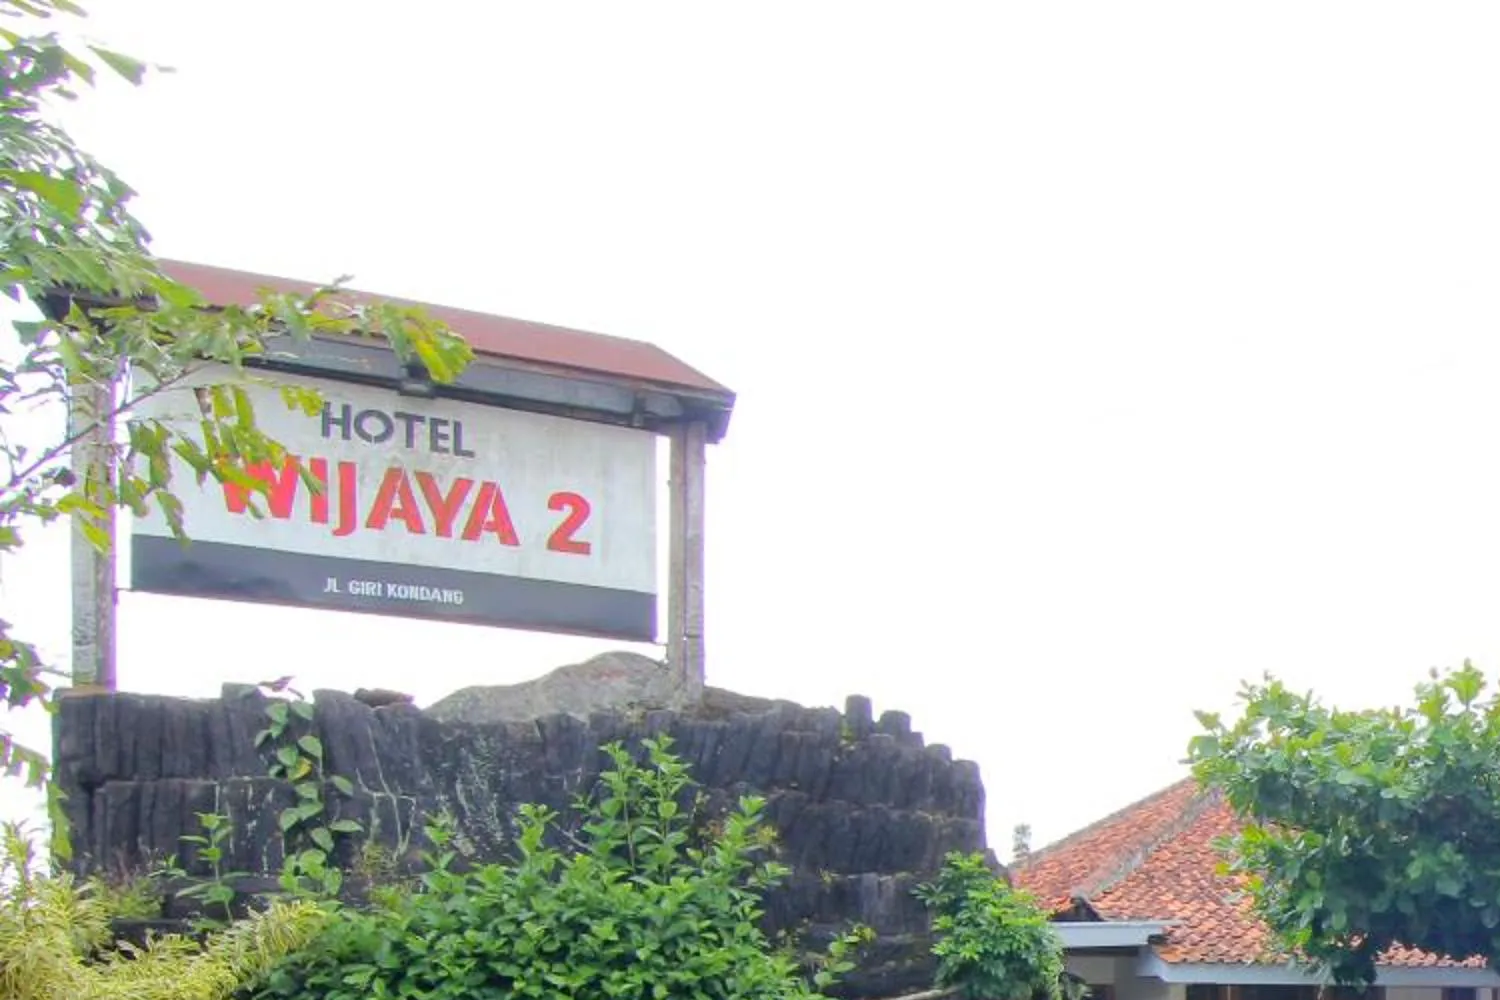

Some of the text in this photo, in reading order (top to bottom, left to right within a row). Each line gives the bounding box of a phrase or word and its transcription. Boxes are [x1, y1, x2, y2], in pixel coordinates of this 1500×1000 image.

[321, 402, 475, 458] HOTEL
[214, 452, 591, 555] WIJAYA 2
[324, 577, 464, 605] JL GIRI KONDANG
